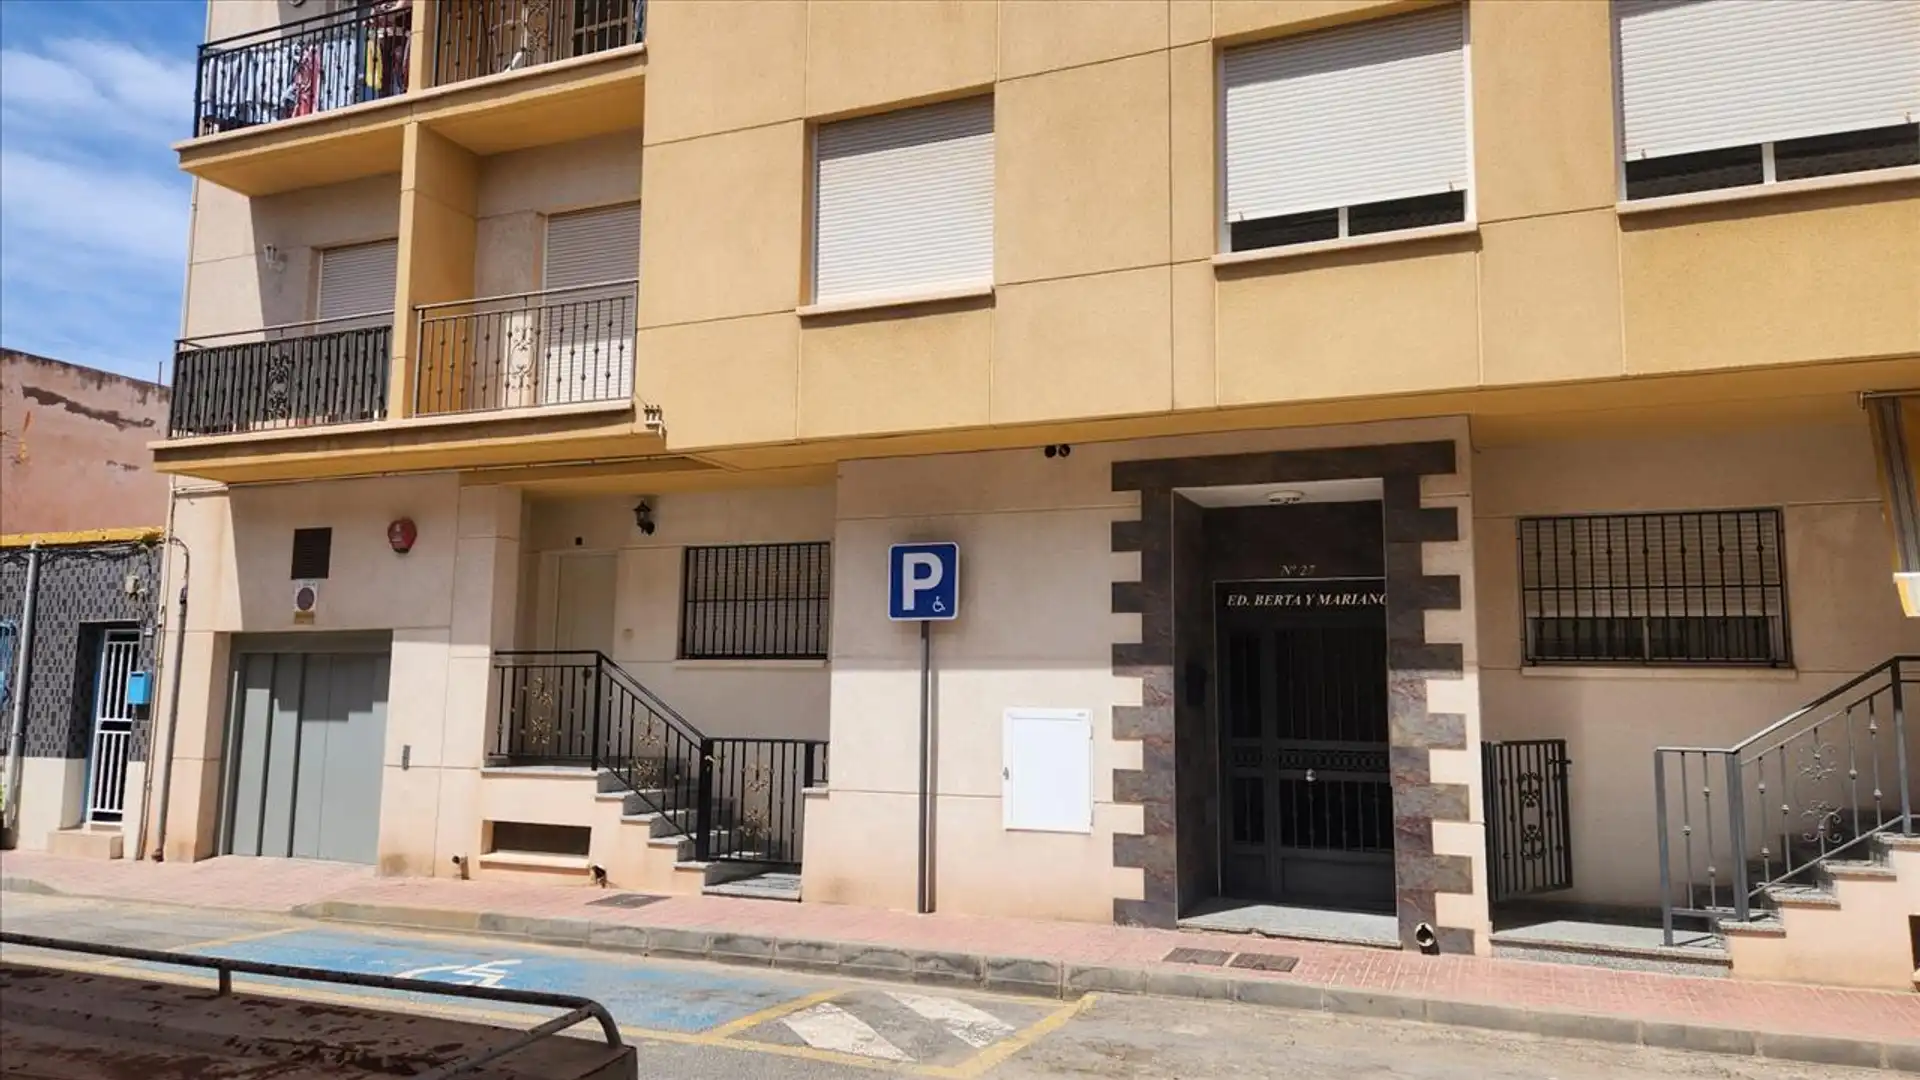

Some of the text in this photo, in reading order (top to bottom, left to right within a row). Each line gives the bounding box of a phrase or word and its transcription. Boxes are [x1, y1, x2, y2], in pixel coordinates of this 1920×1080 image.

[1300, 564, 1316, 576] 27
[902, 552, 944, 611] P
[1227, 594, 1250, 606] ED.
[1254, 594, 1301, 606] BERTA
[1305, 593, 1315, 606] Y
